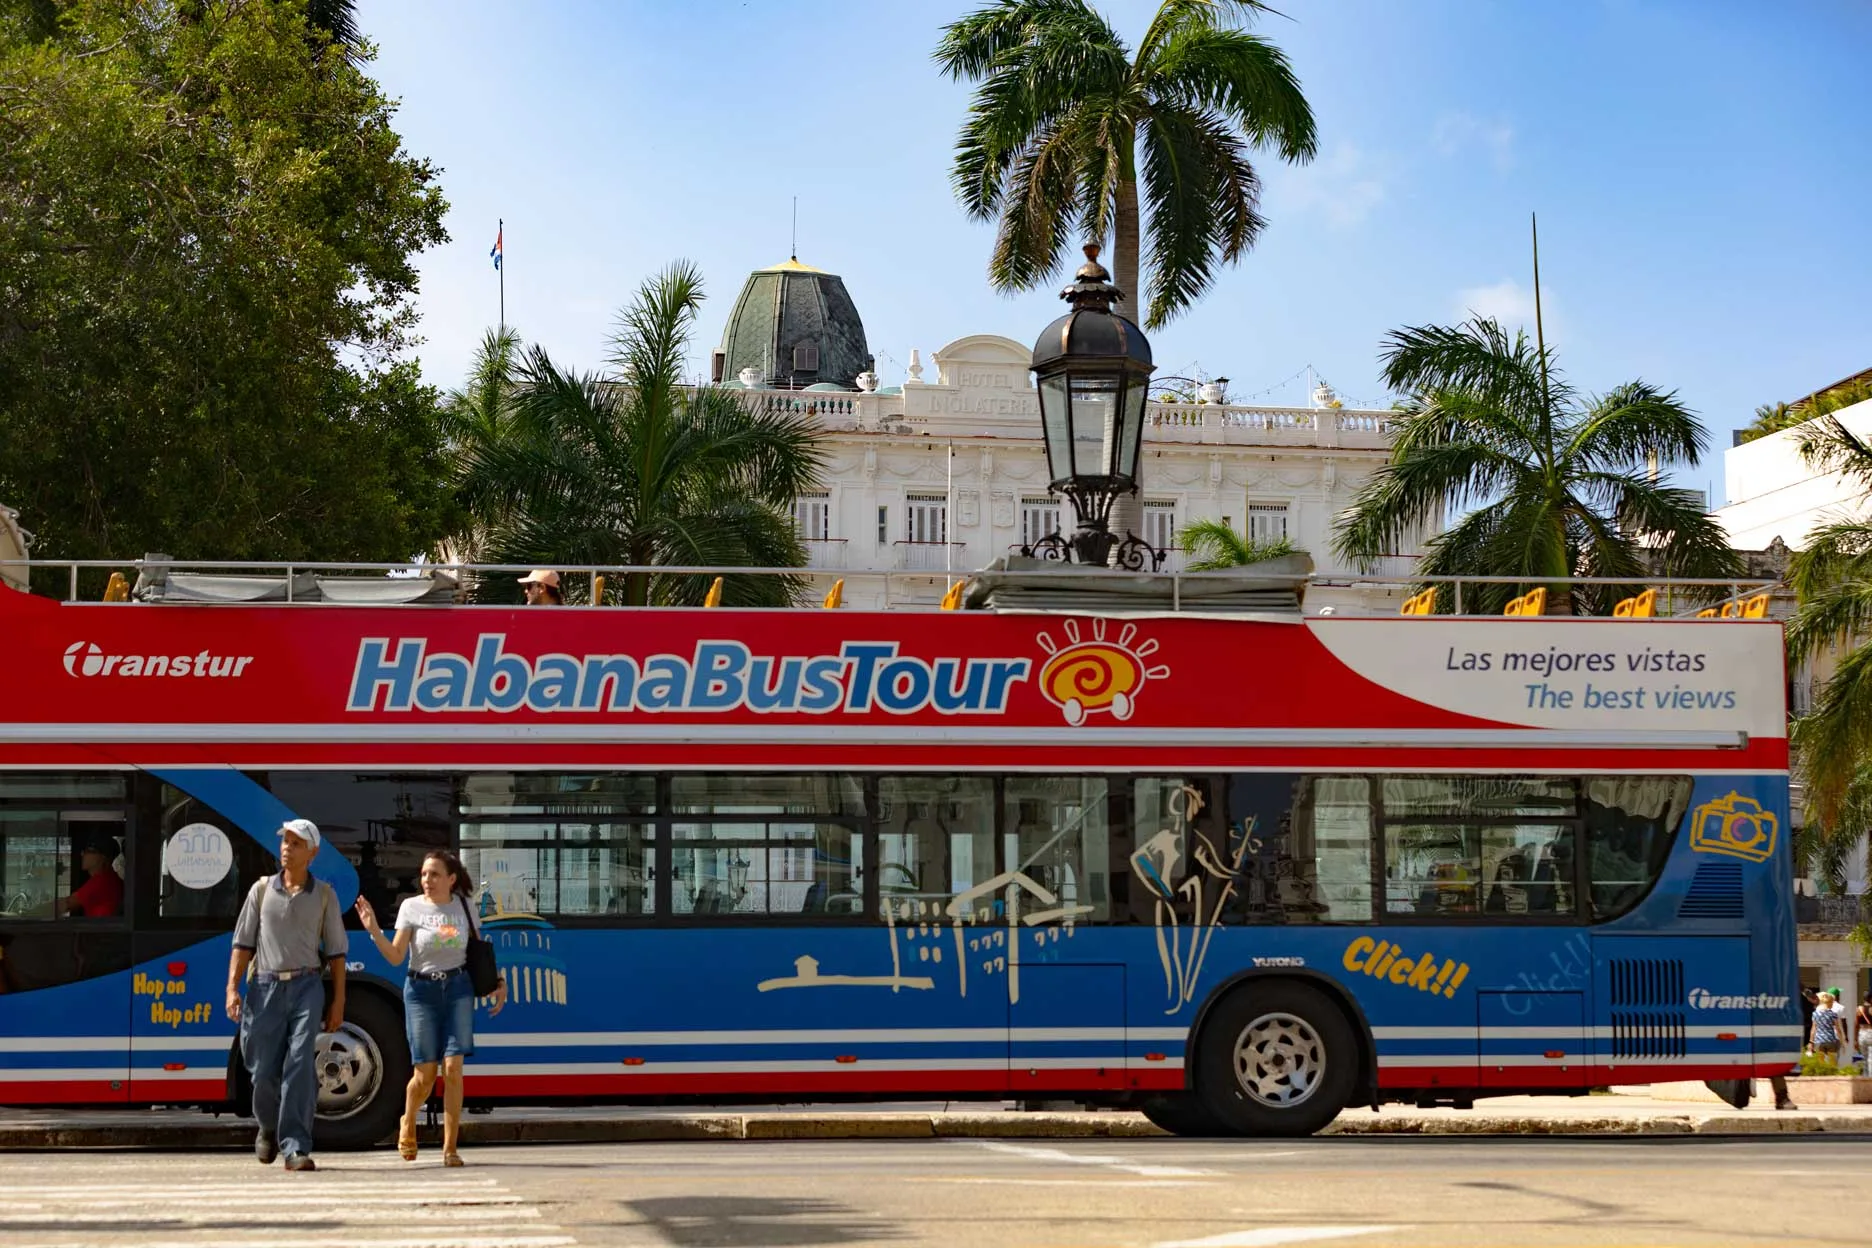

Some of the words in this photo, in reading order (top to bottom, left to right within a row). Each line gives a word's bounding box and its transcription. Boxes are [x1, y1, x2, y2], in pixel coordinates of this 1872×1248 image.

[961, 372, 1012, 389] HOTEL
[1446, 647, 1492, 671] Las
[1502, 647, 1616, 677] mejores
[1627, 647, 1706, 672] vistas
[1525, 684, 1573, 709] The
[1583, 684, 1646, 709] best
[1655, 684, 1736, 709] views
[1252, 956, 1305, 968] YUTONG
[1343, 936, 1470, 999] Click!!
[133, 972, 165, 999] Hop
[166, 980, 186, 994] on
[151, 1001, 182, 1029] Hop
[184, 1002, 212, 1023] off
